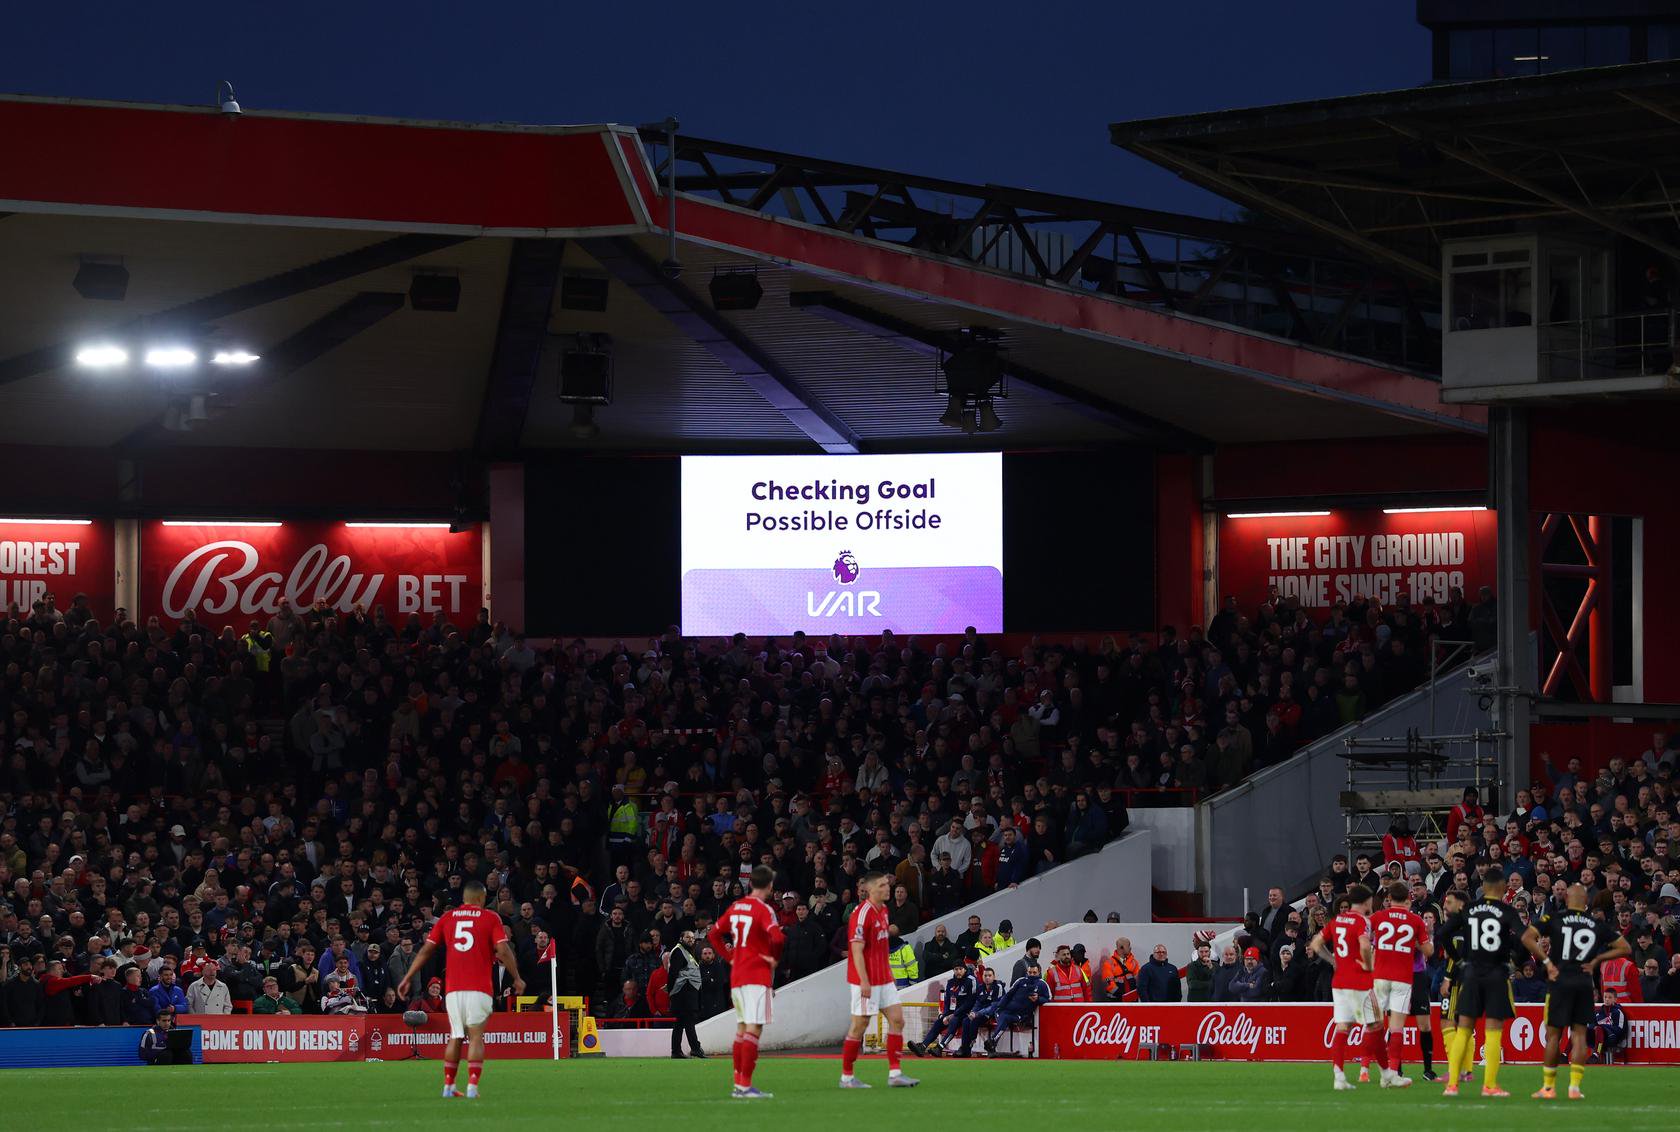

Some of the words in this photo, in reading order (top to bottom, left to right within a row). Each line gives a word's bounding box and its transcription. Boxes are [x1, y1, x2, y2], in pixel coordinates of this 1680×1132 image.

[751, 479, 870, 504] Checking
[877, 478, 936, 499] Goal
[746, 510, 848, 531] Possible
[855, 509, 942, 530] Offside
[1267, 537, 1310, 570] THE
[1314, 535, 1366, 569] CITY
[1371, 532, 1465, 567] GROUND
[161, 540, 385, 619] Bally
[398, 574, 467, 613] BET
[1268, 574, 1330, 607] HOME
[1335, 573, 1402, 607] SINCE
[1407, 571, 1465, 605] 1898
[807, 591, 882, 617] VAR
[454, 920, 474, 952] 5
[1335, 927, 1349, 958] 3
[1378, 921, 1414, 953] 22
[1468, 917, 1501, 952] 18
[1561, 926, 1596, 961] 19
[1441, 998, 1449, 1010] 8
[201, 1029, 240, 1050] COME
[243, 1029, 264, 1050] ON
[267, 1029, 296, 1050] YOU
[300, 1030, 343, 1050] REDS!
[483, 1032, 522, 1043] OOTBALL
[524, 1031, 547, 1043] CLUB
[1073, 1011, 1137, 1053] Bally
[1139, 1026, 1161, 1043] BET
[1197, 1011, 1262, 1053] Bally
[1265, 1026, 1287, 1044] BET
[1402, 1027, 1417, 1045] ET
[1625, 1020, 1680, 1048] FFICIA
